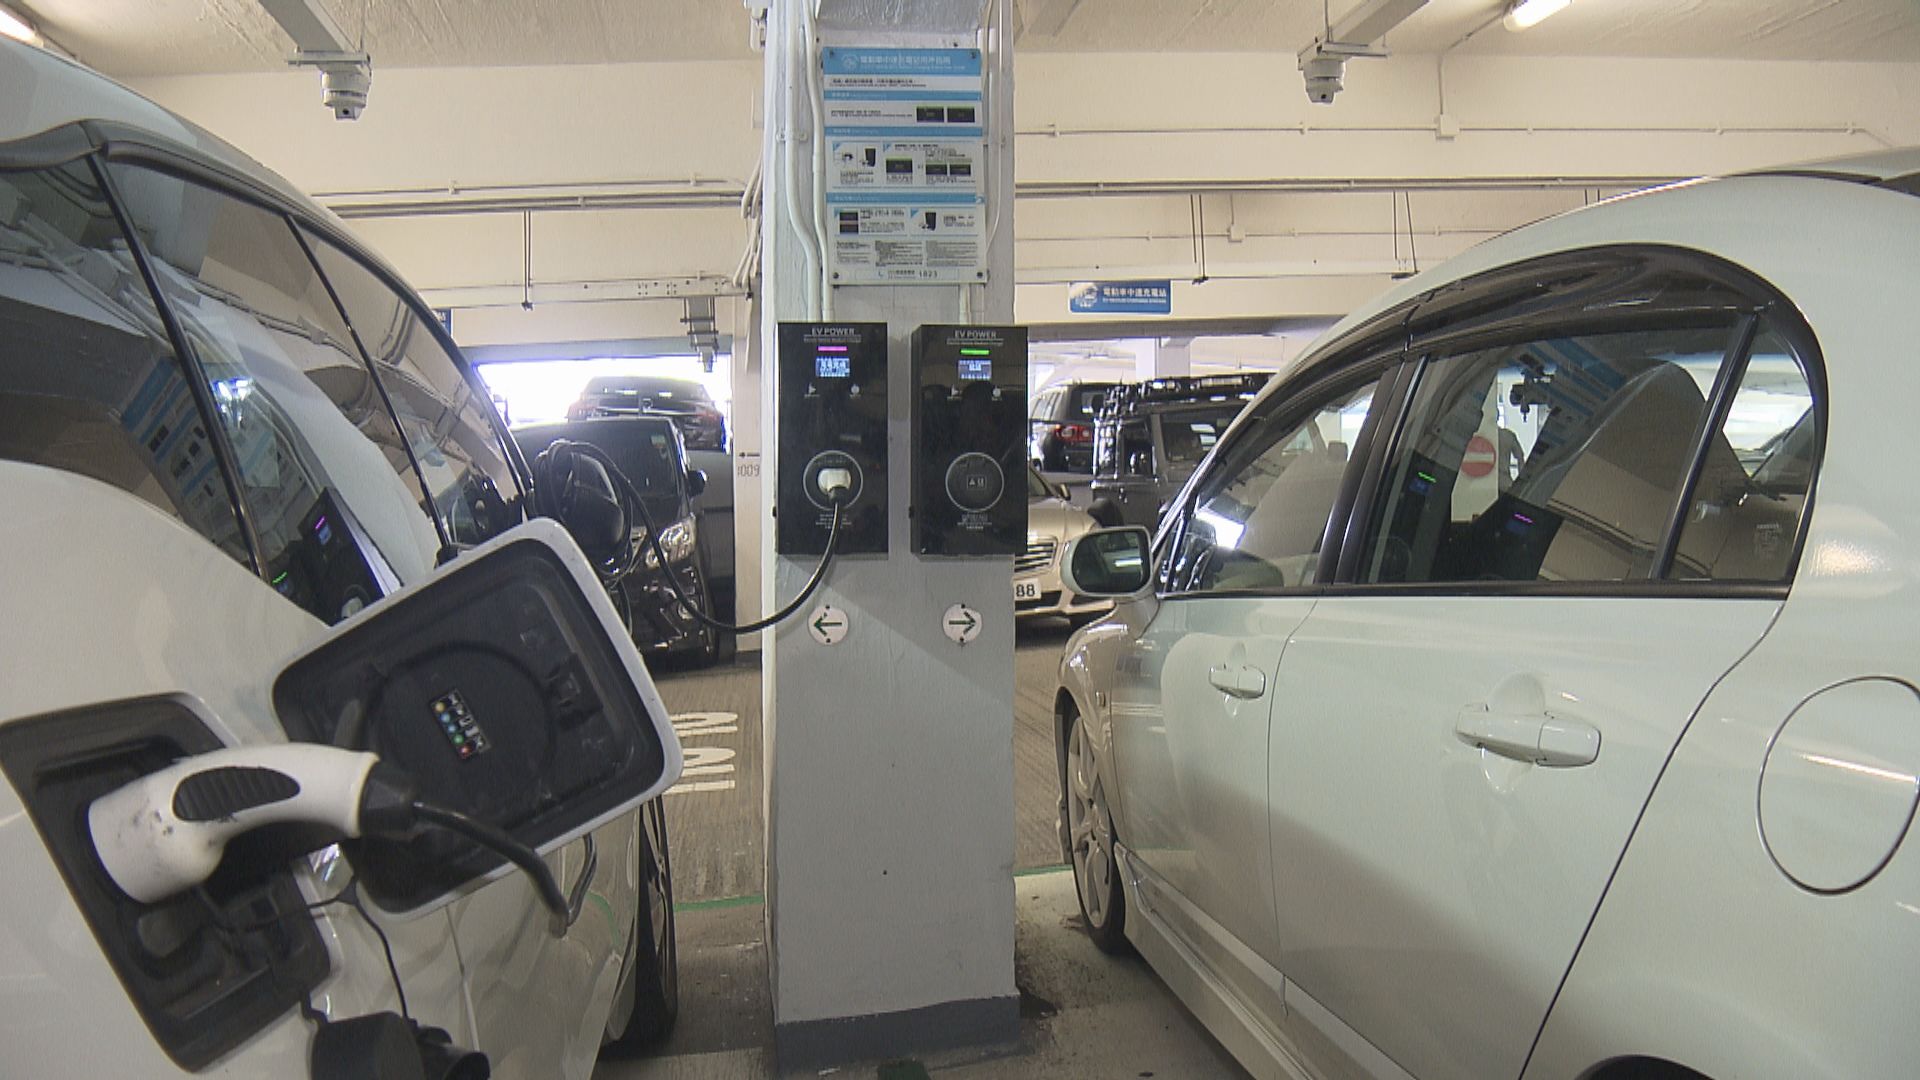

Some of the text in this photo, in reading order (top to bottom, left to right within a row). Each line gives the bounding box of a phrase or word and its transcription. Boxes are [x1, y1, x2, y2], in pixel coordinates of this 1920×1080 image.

[811, 327, 855, 337] EV POWER
[954, 330, 997, 338] EV POWER
